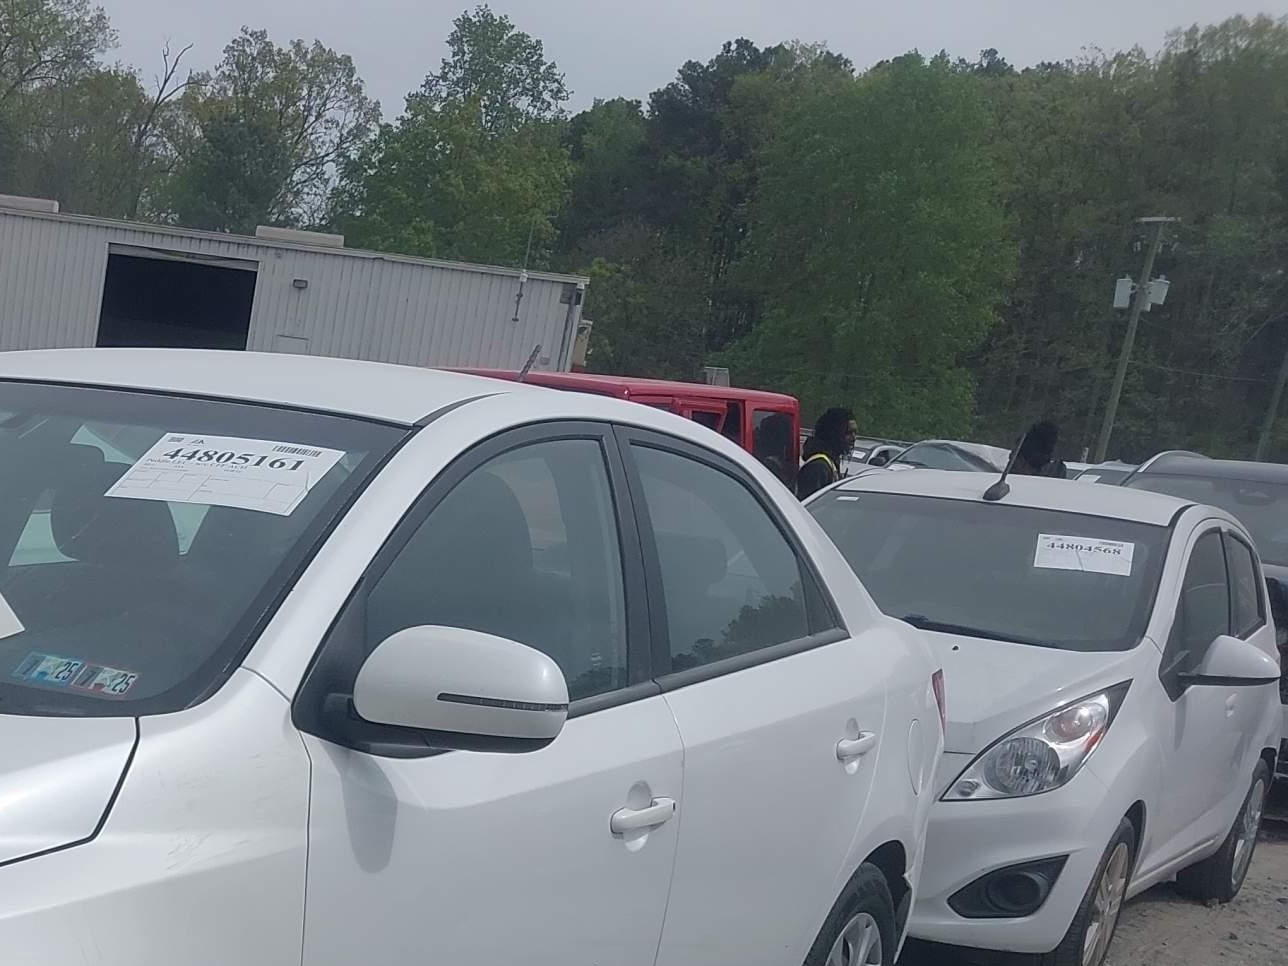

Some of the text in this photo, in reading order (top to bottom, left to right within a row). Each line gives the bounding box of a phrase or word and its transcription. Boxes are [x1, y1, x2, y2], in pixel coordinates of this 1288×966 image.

[163, 447, 305, 471] 44805161
[1047, 542, 1122, 556] 44804568
[54, 661, 79, 681] 25
[112, 673, 135, 694] 25
